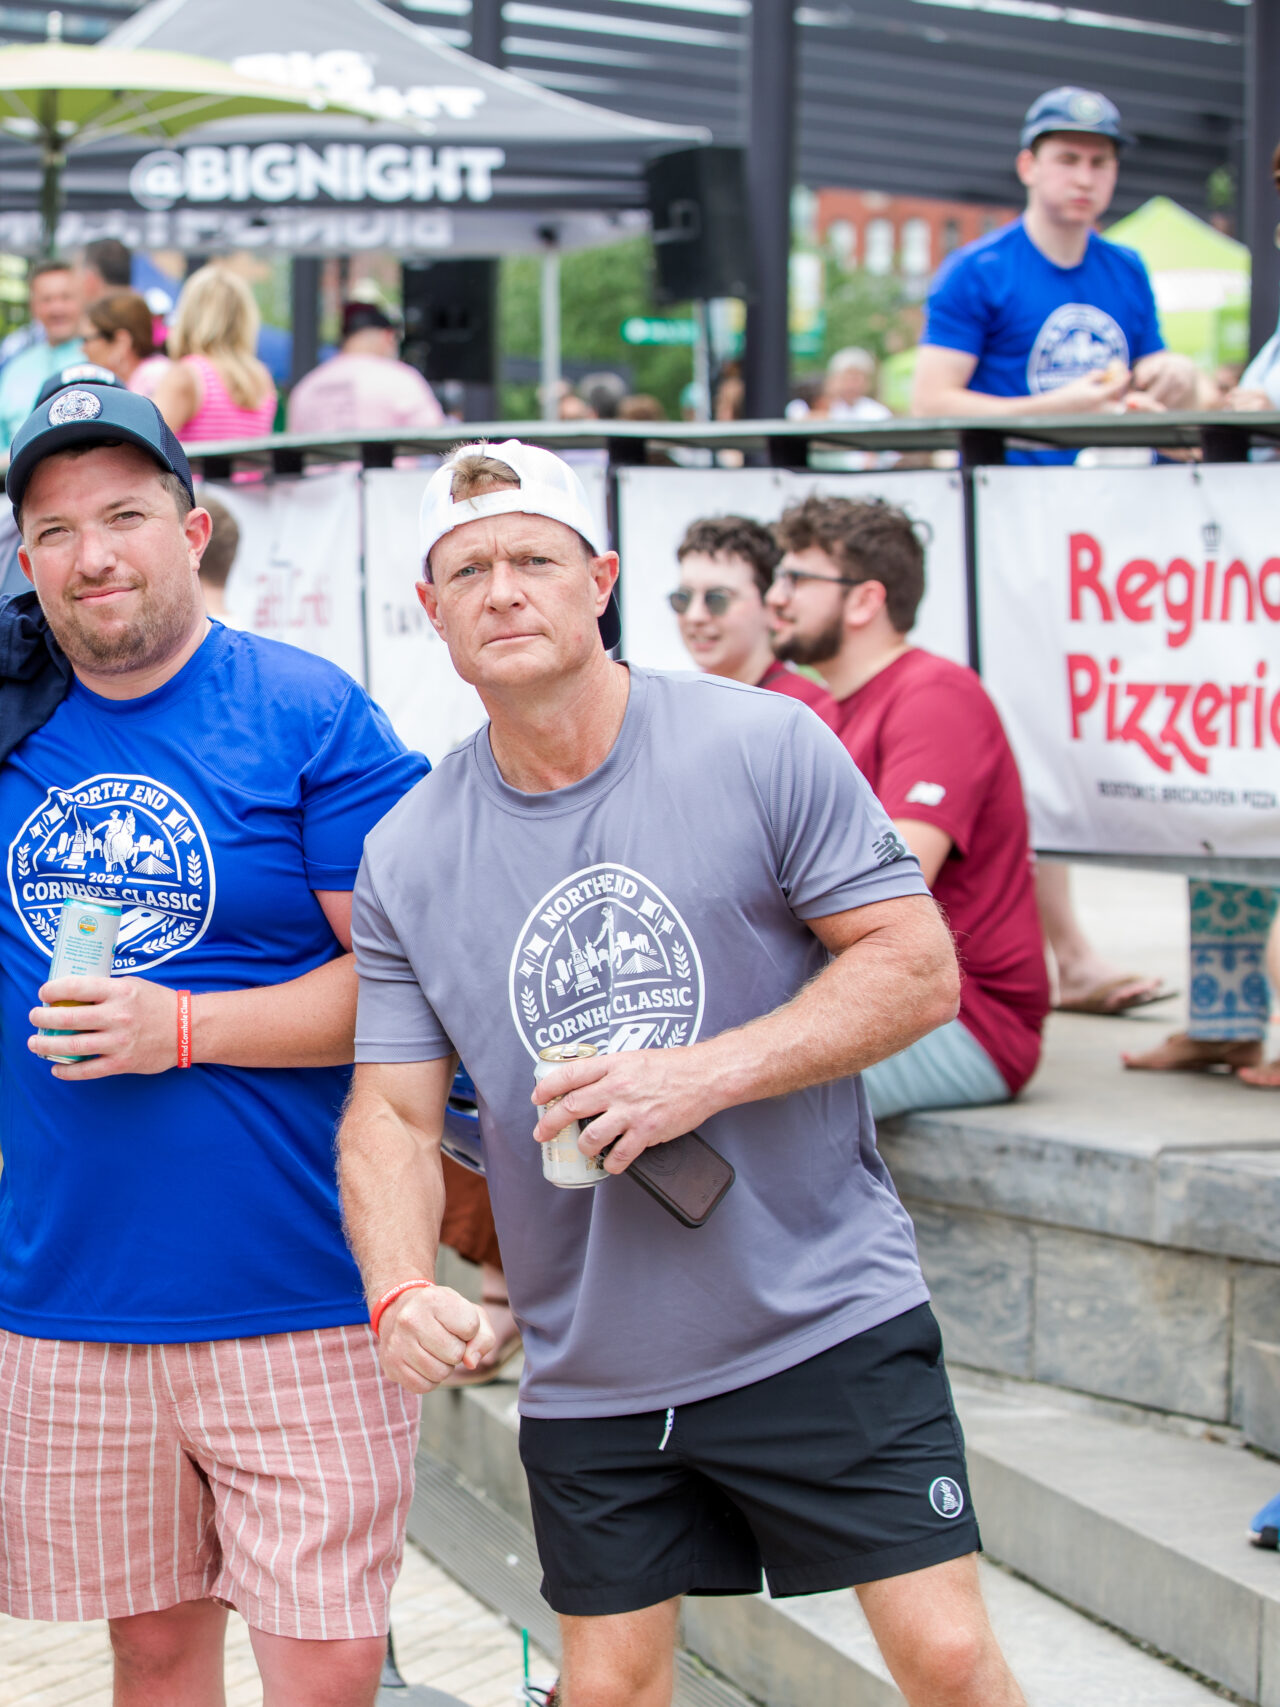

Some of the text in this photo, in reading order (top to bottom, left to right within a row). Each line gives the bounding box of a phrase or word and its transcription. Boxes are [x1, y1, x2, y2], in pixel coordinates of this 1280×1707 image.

[130, 144, 505, 209] @BIGNIGHT
[57, 782, 169, 810] NORTH END
[89, 872, 124, 884] 2026
[23, 881, 203, 912] CORNHOLE CLASSIC
[540, 874, 605, 930] NORTH
[111, 956, 137, 969] 016
[535, 986, 694, 1048] CORNH CLASSIC
